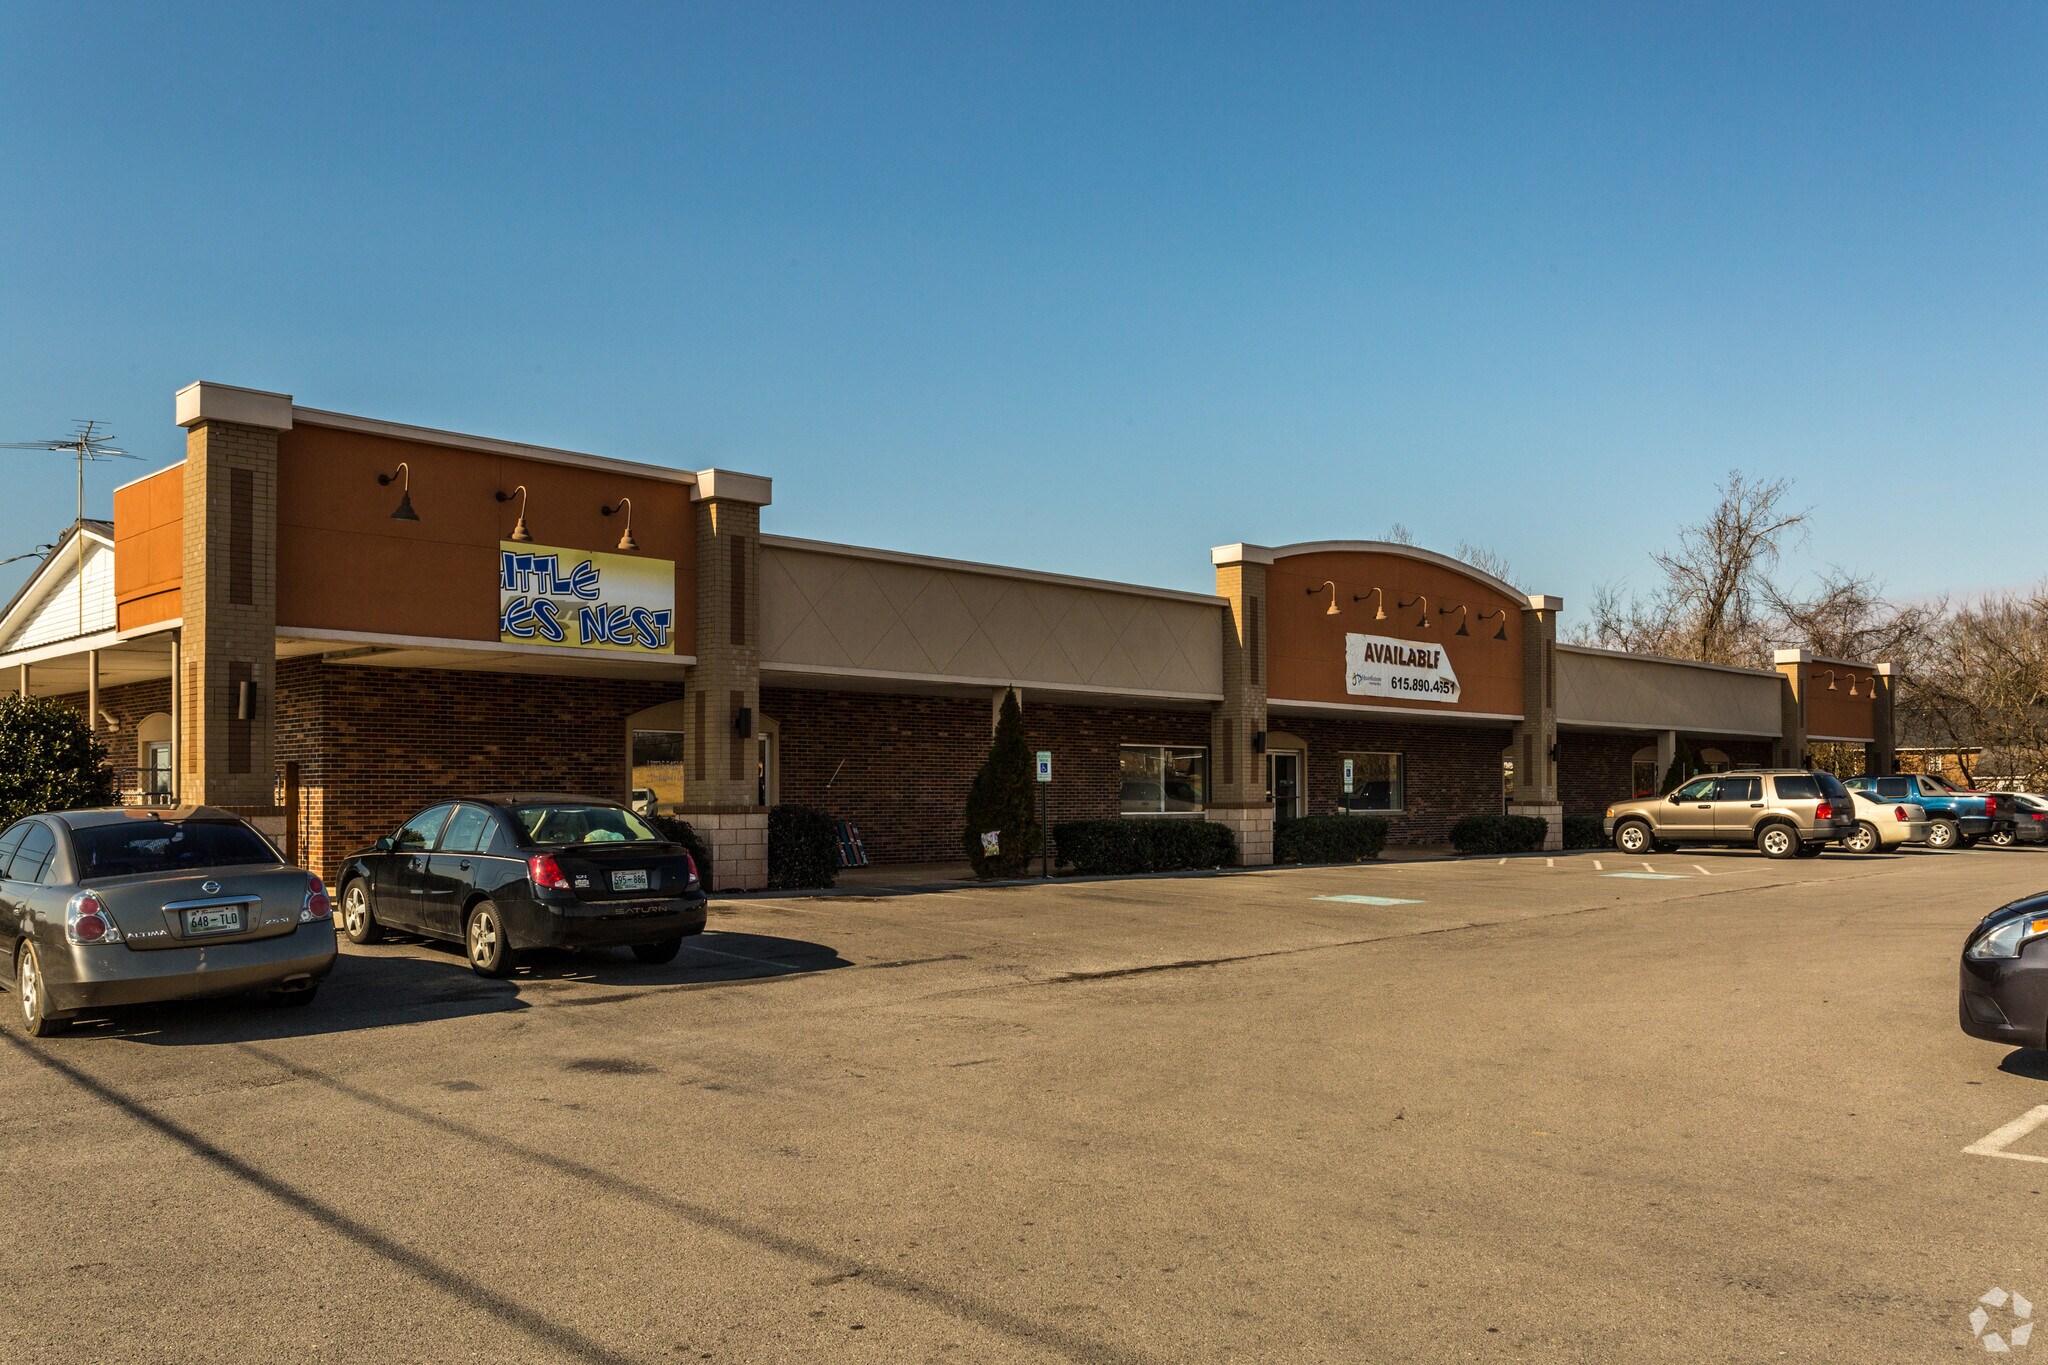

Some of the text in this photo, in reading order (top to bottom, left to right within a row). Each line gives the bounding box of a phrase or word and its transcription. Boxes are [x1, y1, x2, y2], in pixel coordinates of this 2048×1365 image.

[500, 550, 600, 600] ITTLE
[500, 596, 671, 649] ES NEST
[615, 906, 667, 914] SATURN
[127, 930, 167, 938] ALTIMA
